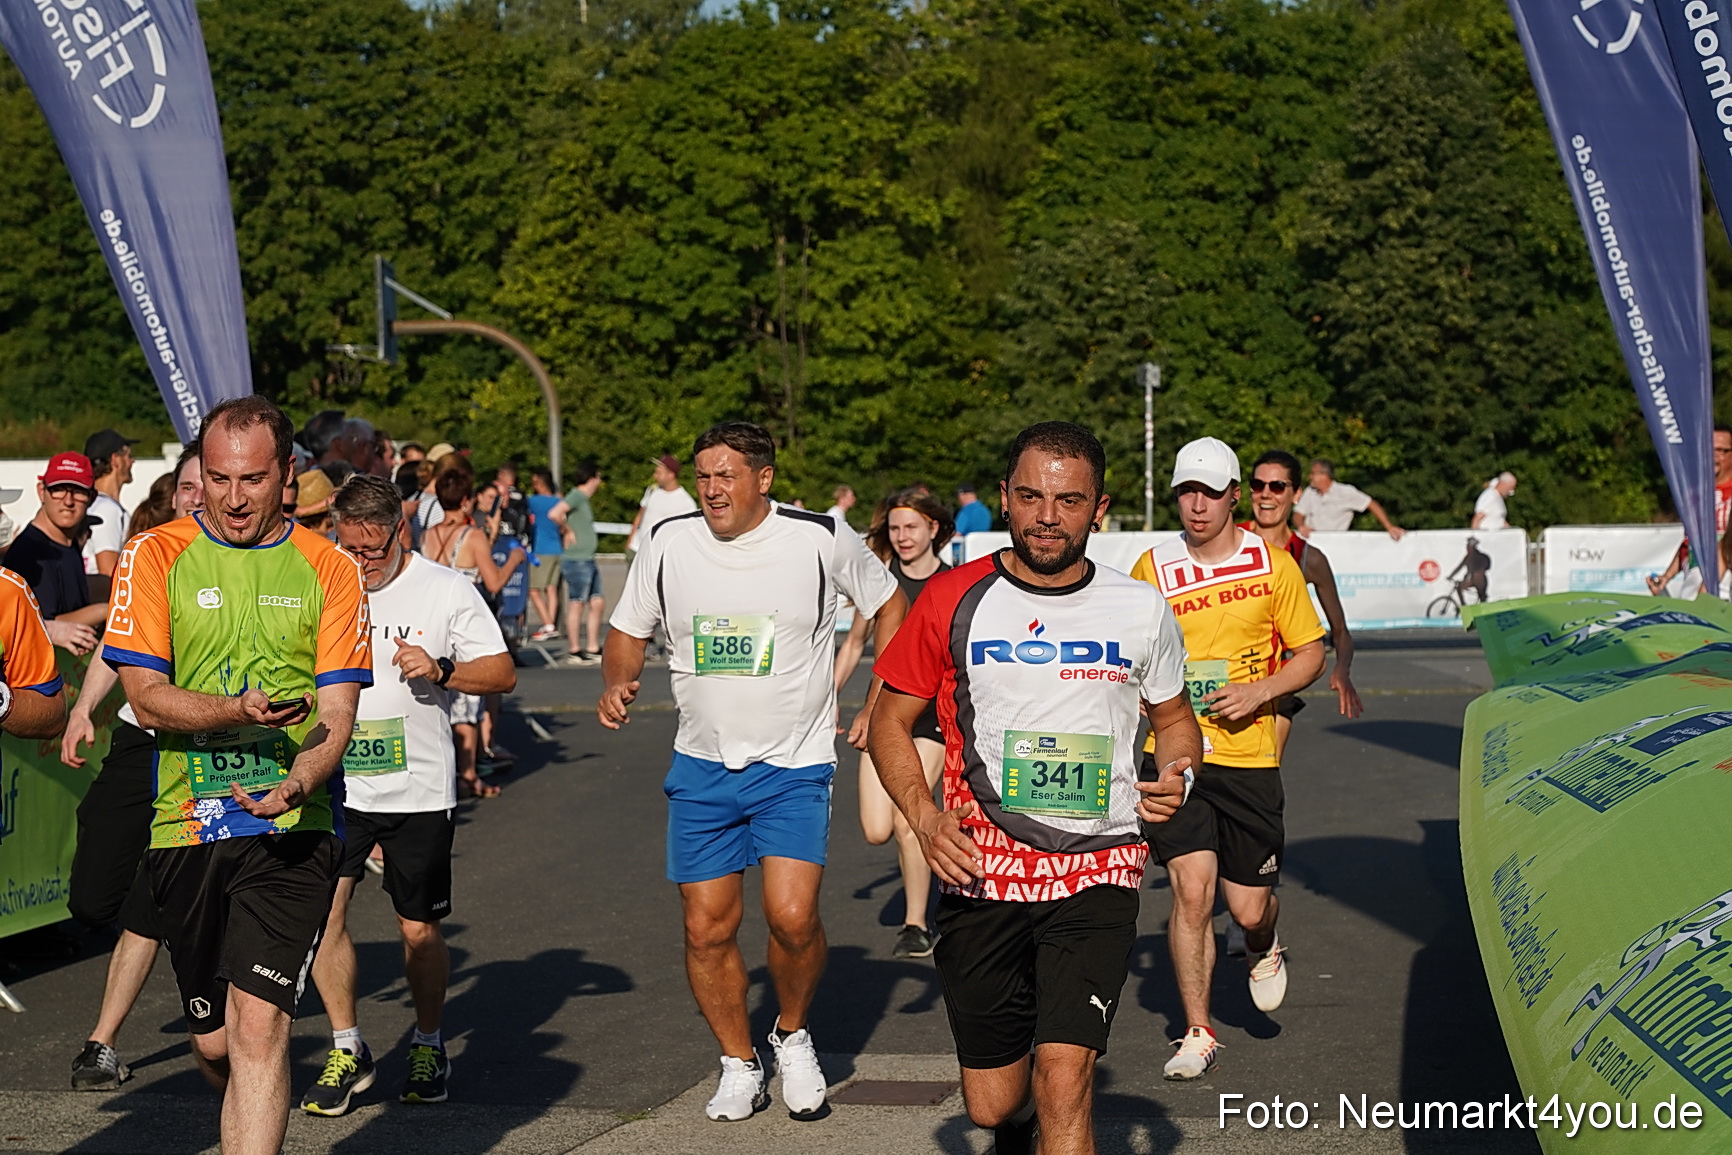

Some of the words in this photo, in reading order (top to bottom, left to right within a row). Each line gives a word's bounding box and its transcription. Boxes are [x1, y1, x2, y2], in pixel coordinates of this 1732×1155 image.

[1570, 549, 1604, 562] NOW
[258, 594, 302, 608] BOCK
[1218, 582, 1273, 605] BÖGL
[697, 642, 705, 664] RUN
[712, 636, 752, 655] 586
[728, 656, 755, 664] Steffen
[1060, 662, 1129, 684] energie
[211, 741, 261, 772] 631
[274, 741, 288, 776] 2022
[346, 739, 385, 757] 236
[393, 739, 403, 765] 2022
[193, 757, 205, 783] RUN
[370, 757, 392, 765] Klaus
[209, 770, 250, 784] Pröpster
[252, 766, 272, 778] Ralf
[1008, 768, 1019, 797] RUN
[1031, 761, 1085, 790] 341
[1031, 790, 1055, 800] Eser
[1057, 791, 1086, 802] Salim
[1097, 769, 1107, 806] 2022
[251, 963, 293, 987] saller
[1585, 1036, 1655, 1100] neumarkt
